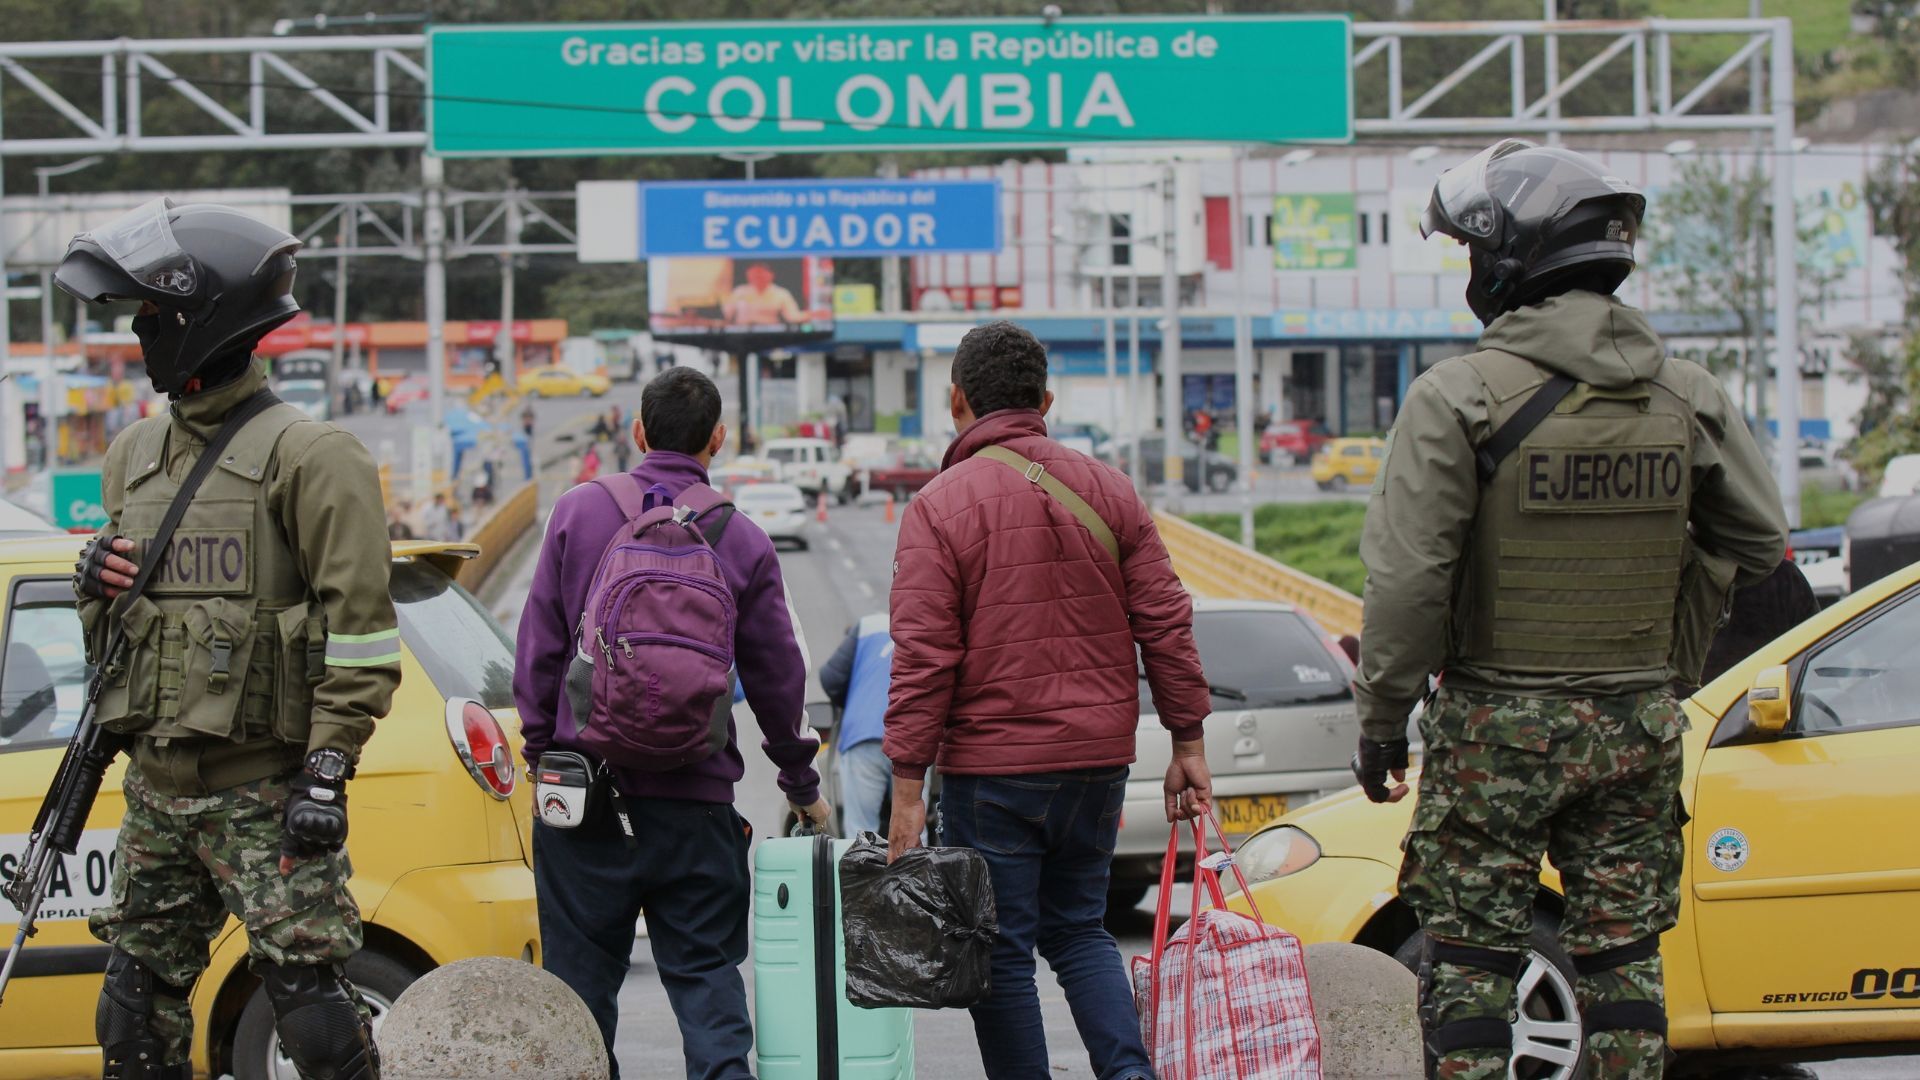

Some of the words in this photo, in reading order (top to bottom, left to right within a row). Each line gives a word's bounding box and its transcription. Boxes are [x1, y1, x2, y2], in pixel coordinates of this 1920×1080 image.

[561, 36, 705, 66] Gracias
[716, 39, 782, 69] por
[793, 33, 912, 62] visitar
[924, 33, 958, 61] la
[970, 30, 1159, 66] República
[1171, 30, 1218, 58] de
[643, 71, 1135, 134] COLOMBIA
[703, 213, 937, 249] ECUADOR
[1528, 451, 1682, 501] EJERCITO
[142, 536, 243, 584] RCITO
[618, 812, 635, 837] NIKE
[0, 853, 73, 900] SA
[40, 906, 97, 919] IPIAL
[1761, 991, 1849, 1004] SERVICIO
